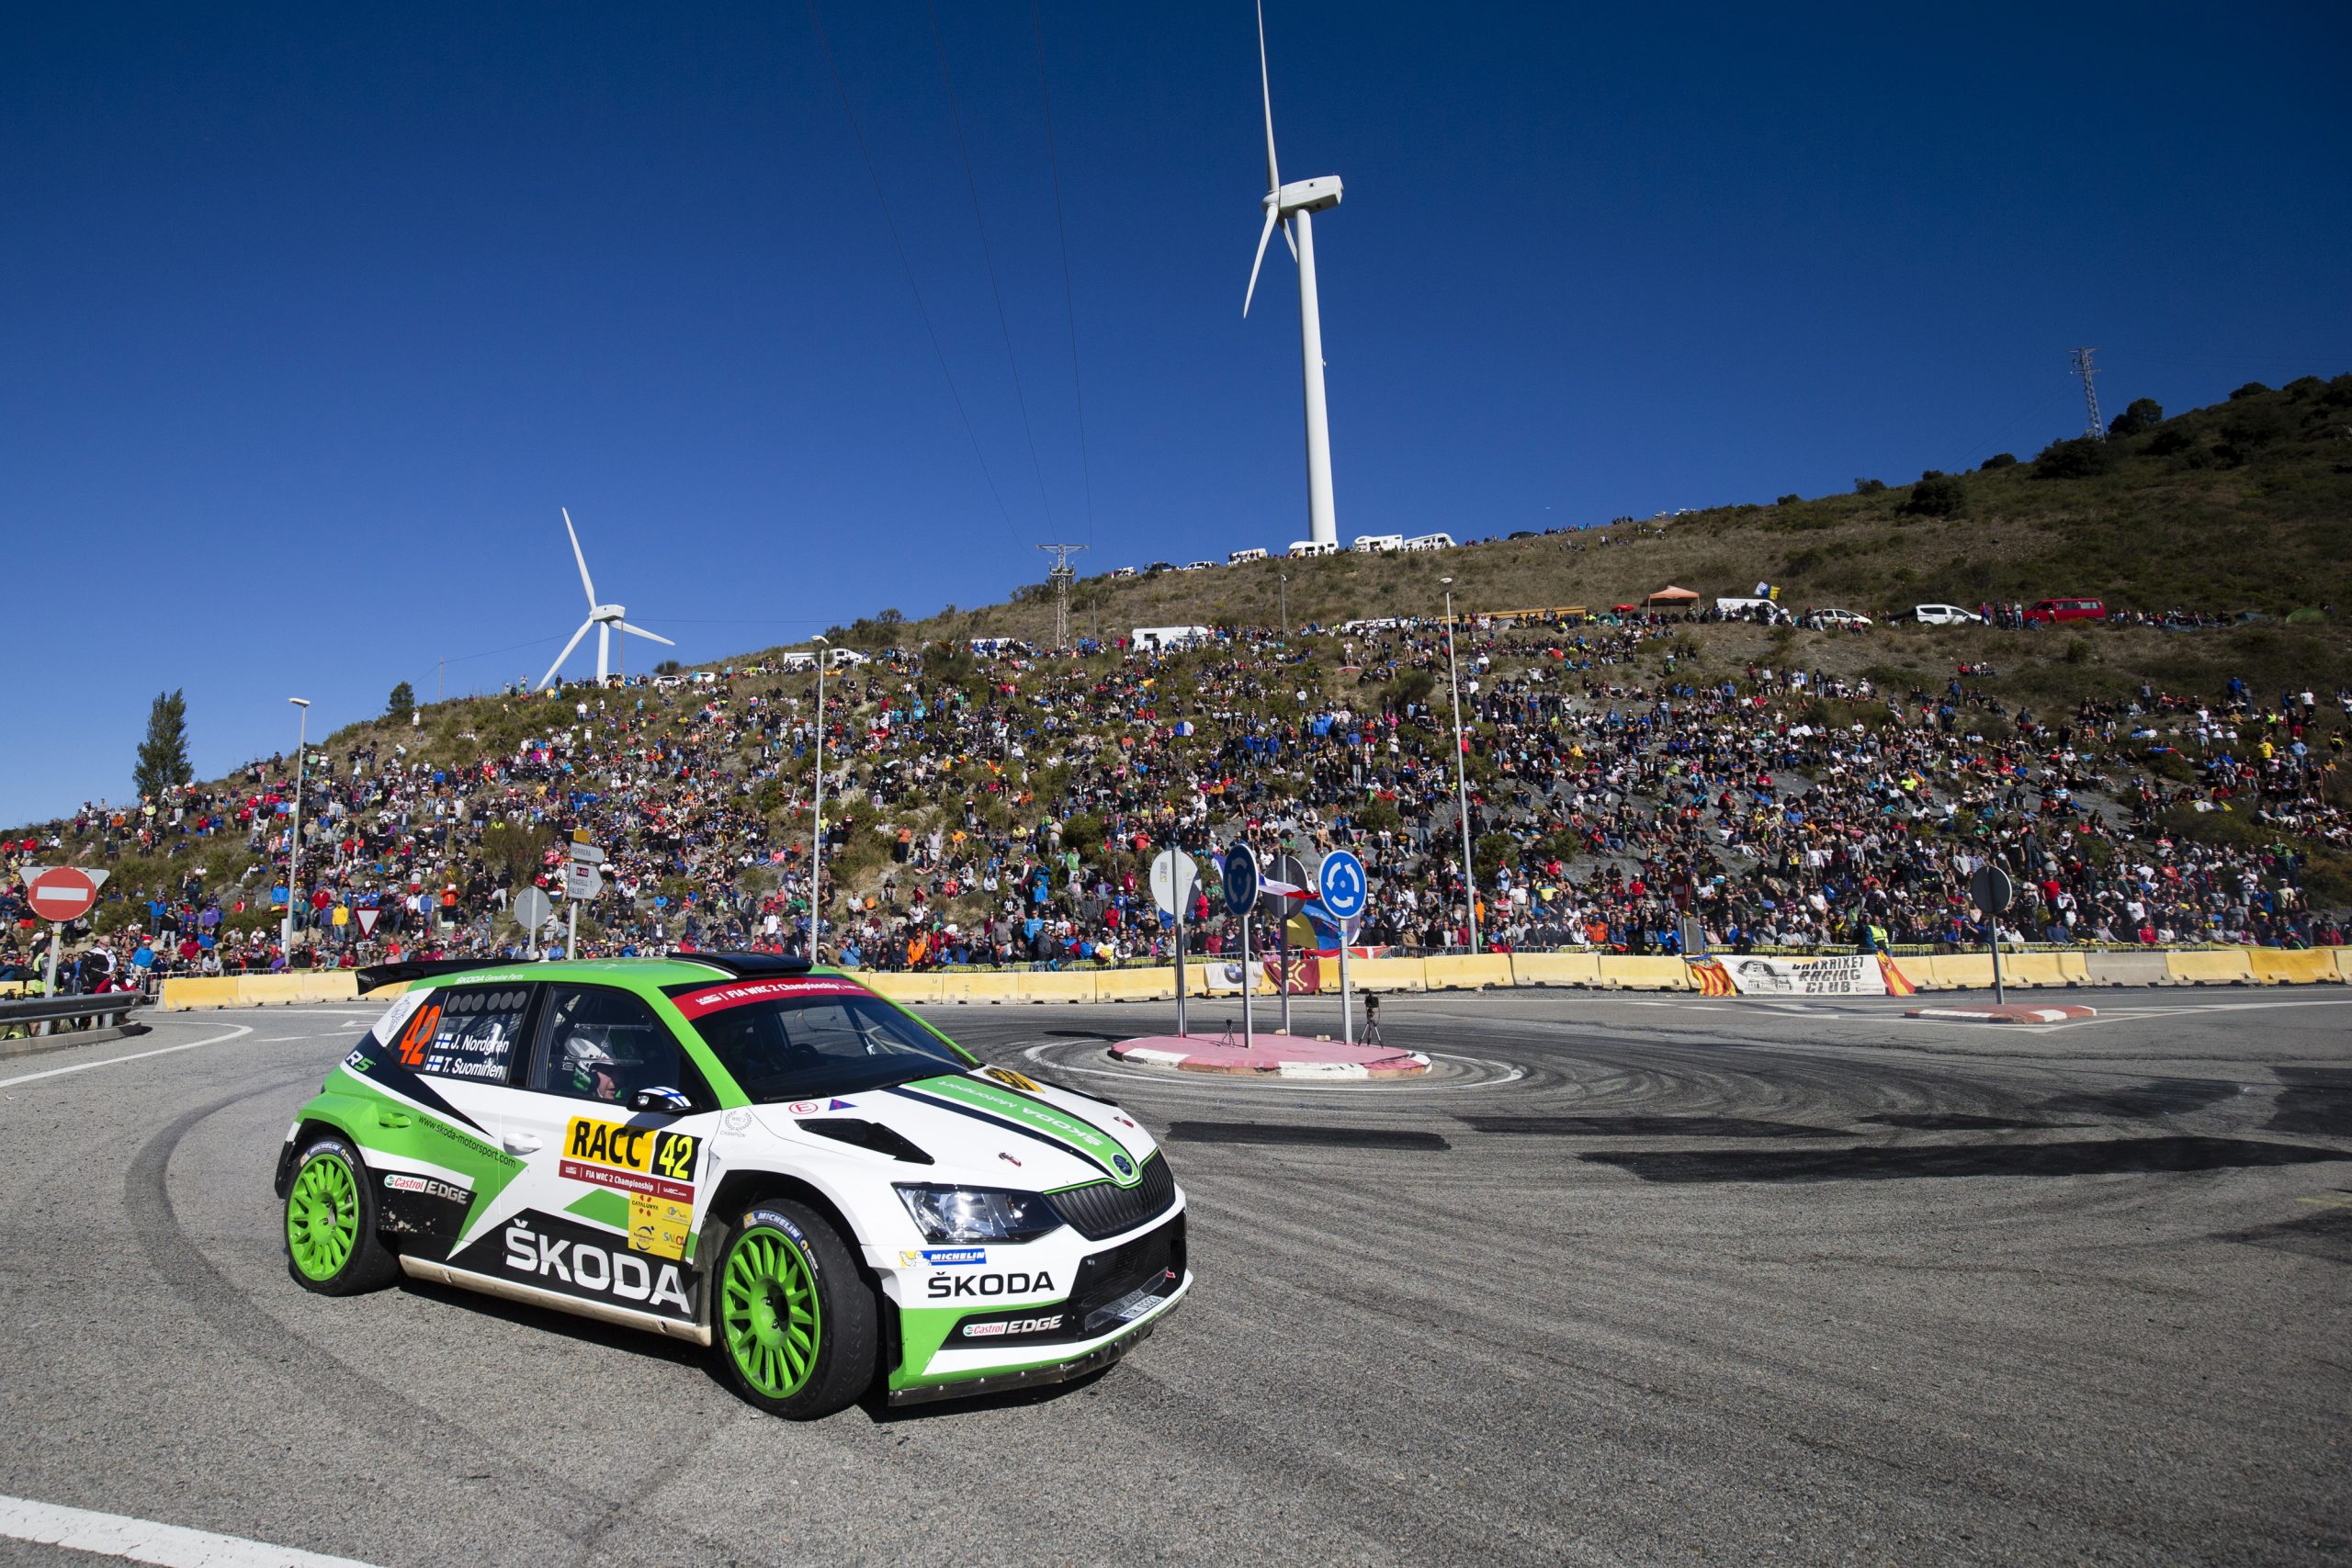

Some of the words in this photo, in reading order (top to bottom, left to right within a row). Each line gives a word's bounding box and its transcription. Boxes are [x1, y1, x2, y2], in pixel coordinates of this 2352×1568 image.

[1798, 969, 1861, 982] RACING
[1805, 981, 1851, 993] CLUB
[727, 990, 746, 998] FIA
[745, 986, 770, 996] WRC
[778, 983, 840, 991] Championship
[399, 1005, 442, 1066] 42
[451, 1034, 459, 1049] J.
[461, 1034, 510, 1055] Nordgren
[442, 1057, 450, 1073] T.
[452, 1058, 503, 1079] Suominen
[937, 1080, 1018, 1109] Motorsport
[419, 1115, 516, 1168] www.skoda-motorsport.com
[571, 1121, 648, 1168] RACC
[659, 1134, 693, 1180] 42
[394, 1177, 424, 1190] Castrol
[425, 1180, 469, 1205] EDGE
[585, 1170, 594, 1179] FIA
[595, 1172, 609, 1182] WRC
[614, 1176, 654, 1193] Championship
[757, 1213, 801, 1238] MICHELIN
[506, 1218, 691, 1314] ŠKODA
[930, 1251, 985, 1261] MICHELIN
[928, 1271, 1055, 1298] ŠKODA
[973, 1324, 1004, 1335] Castrol
[1006, 1314, 1064, 1335] EDGE
